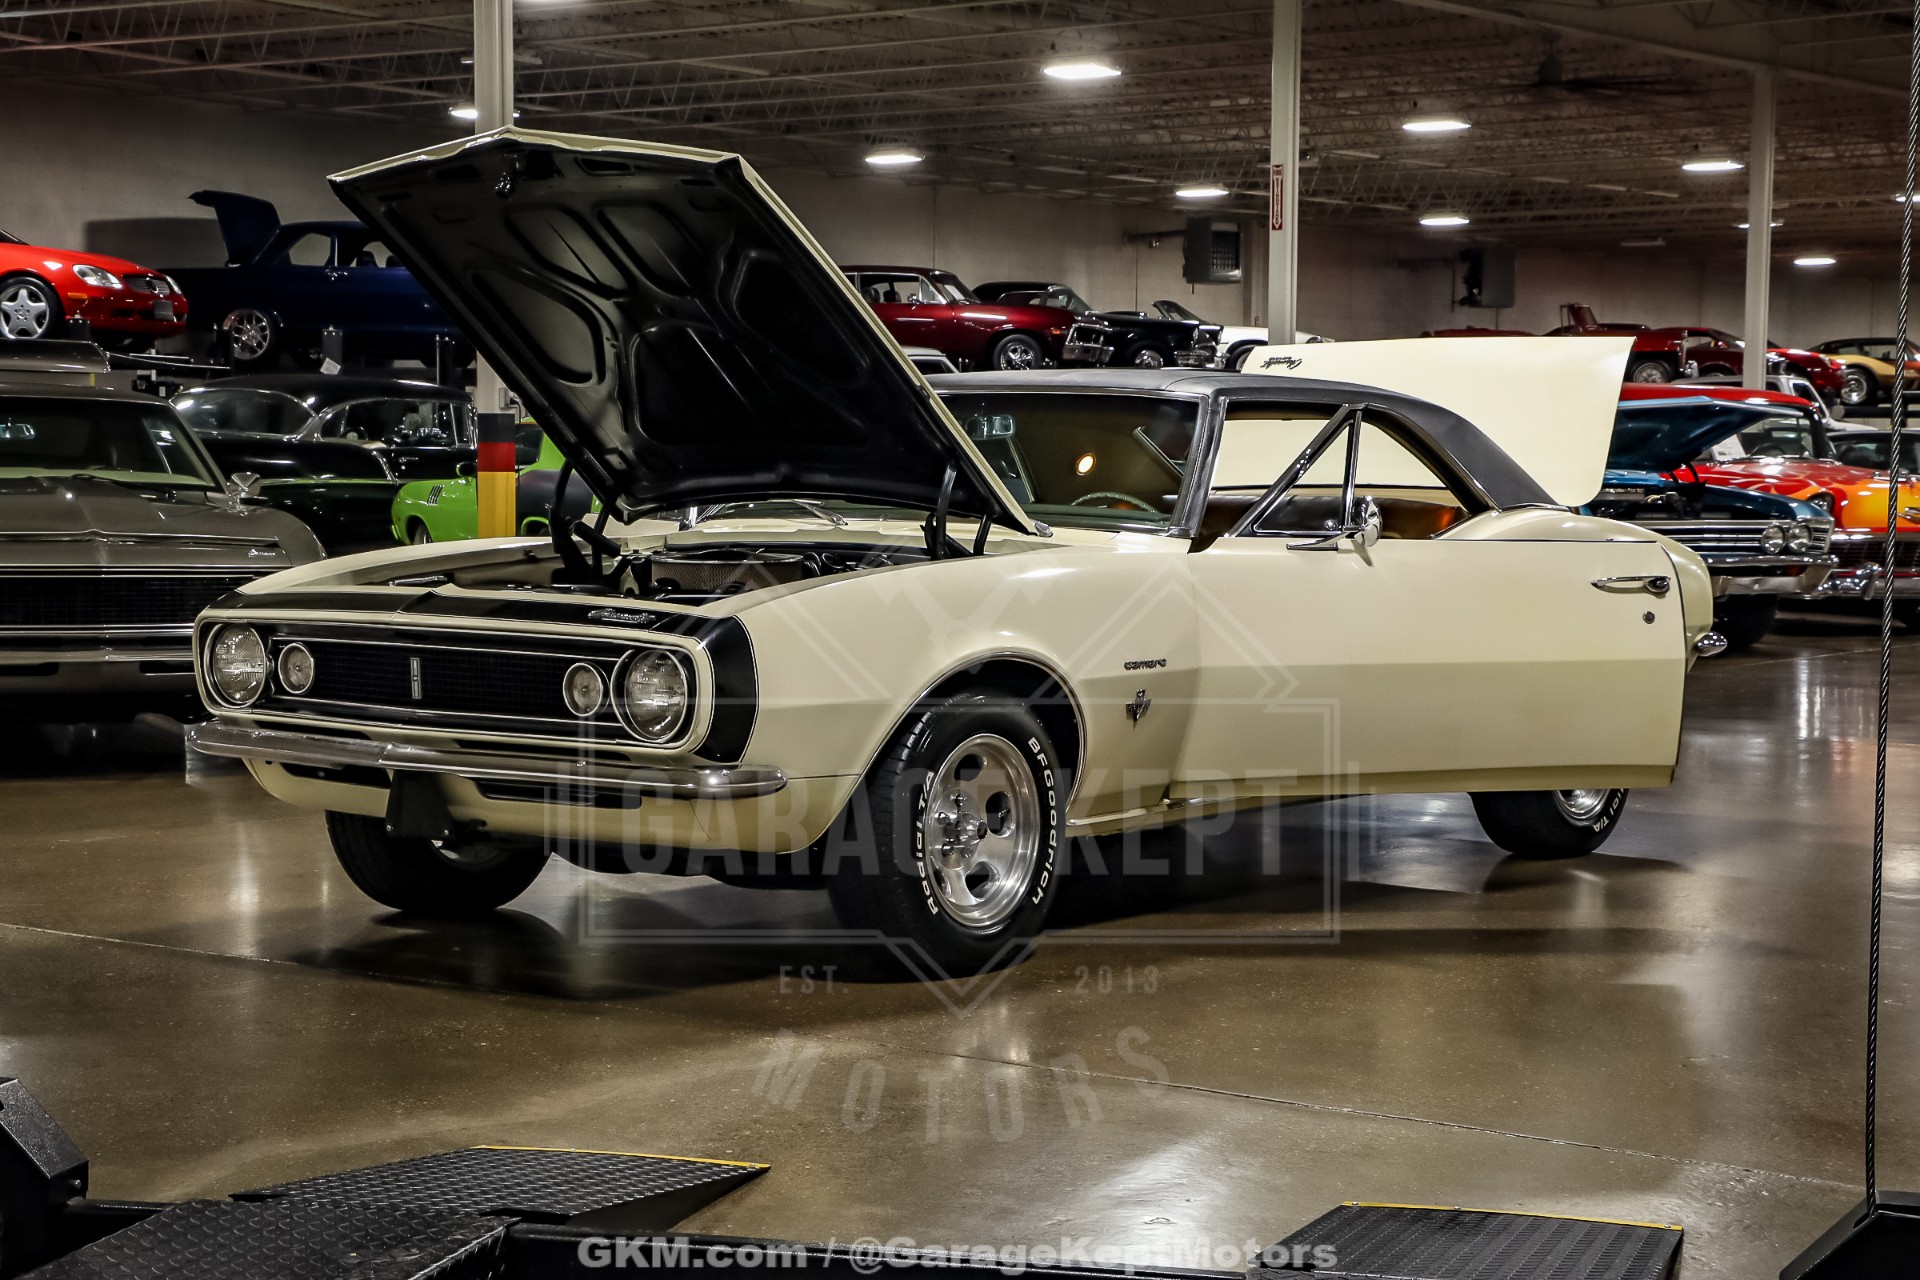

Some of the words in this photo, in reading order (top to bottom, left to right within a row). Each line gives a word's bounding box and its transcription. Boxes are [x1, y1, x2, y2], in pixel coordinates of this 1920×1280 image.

[1124, 658, 1167, 670] camaro
[919, 771, 934, 809] T/A
[1028, 737, 1057, 904] BFGoodrich
[1593, 815, 1609, 832] T/A
[916, 820, 938, 915] Radial
